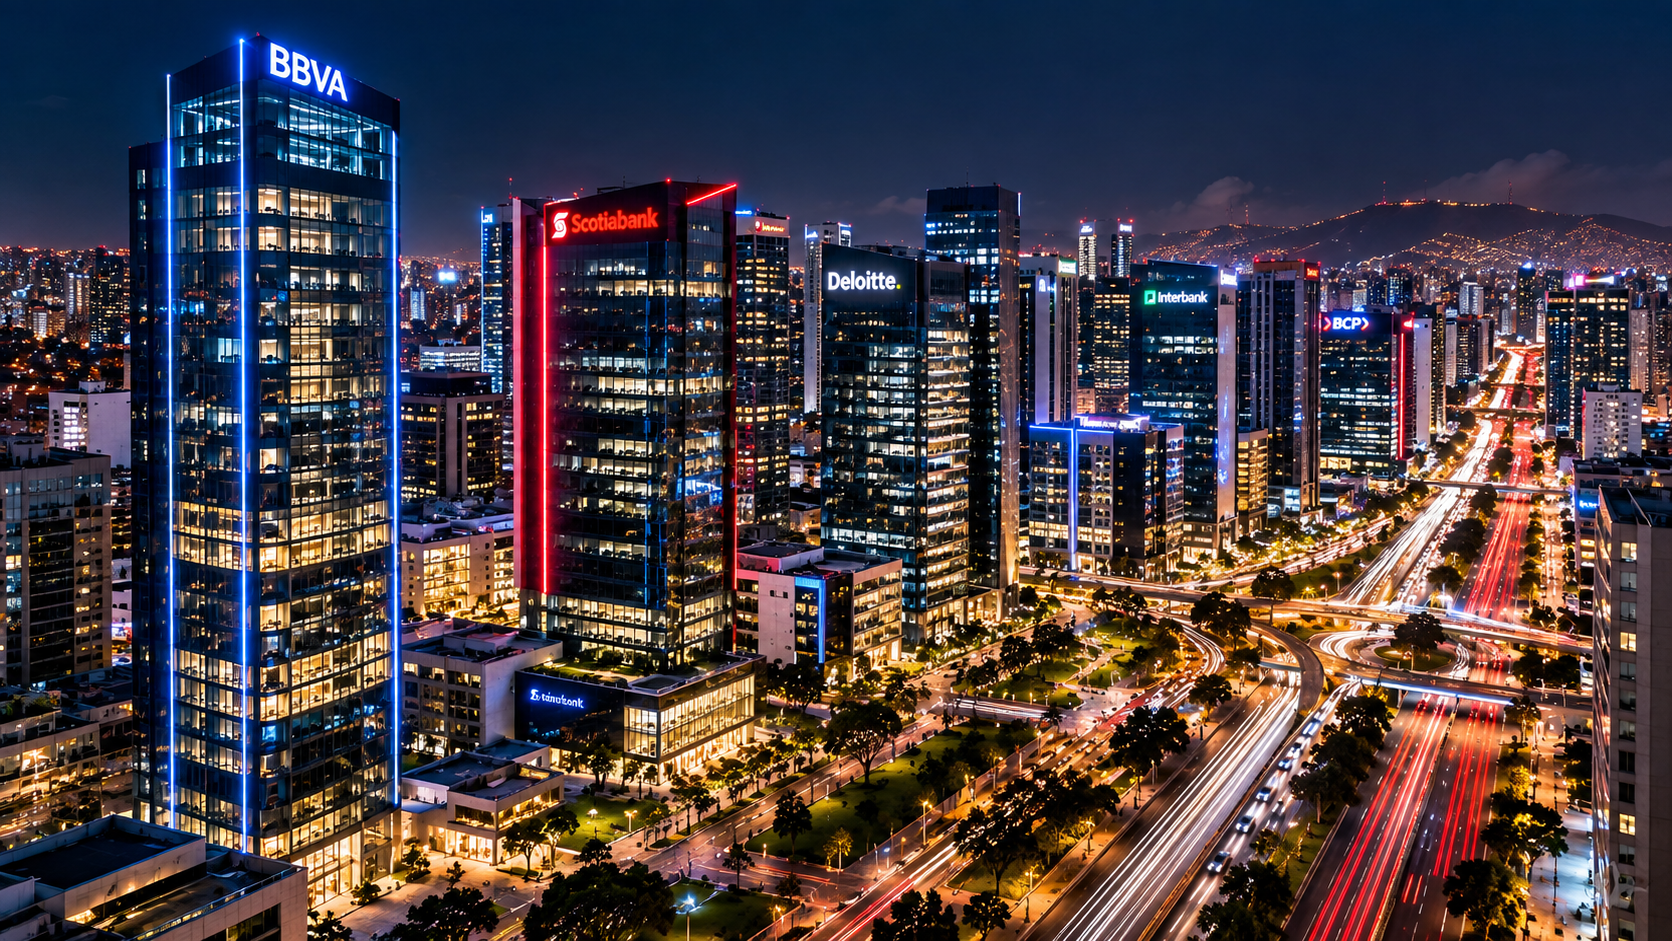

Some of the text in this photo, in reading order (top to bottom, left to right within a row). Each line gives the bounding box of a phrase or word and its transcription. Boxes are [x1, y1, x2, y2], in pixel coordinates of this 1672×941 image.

[270, 42, 348, 102] BBVA
[571, 207, 659, 233] Scotiabank
[828, 270, 901, 290] Deloitte.
[1158, 291, 1208, 303] Interbank
[1332, 317, 1362, 330] BCP
